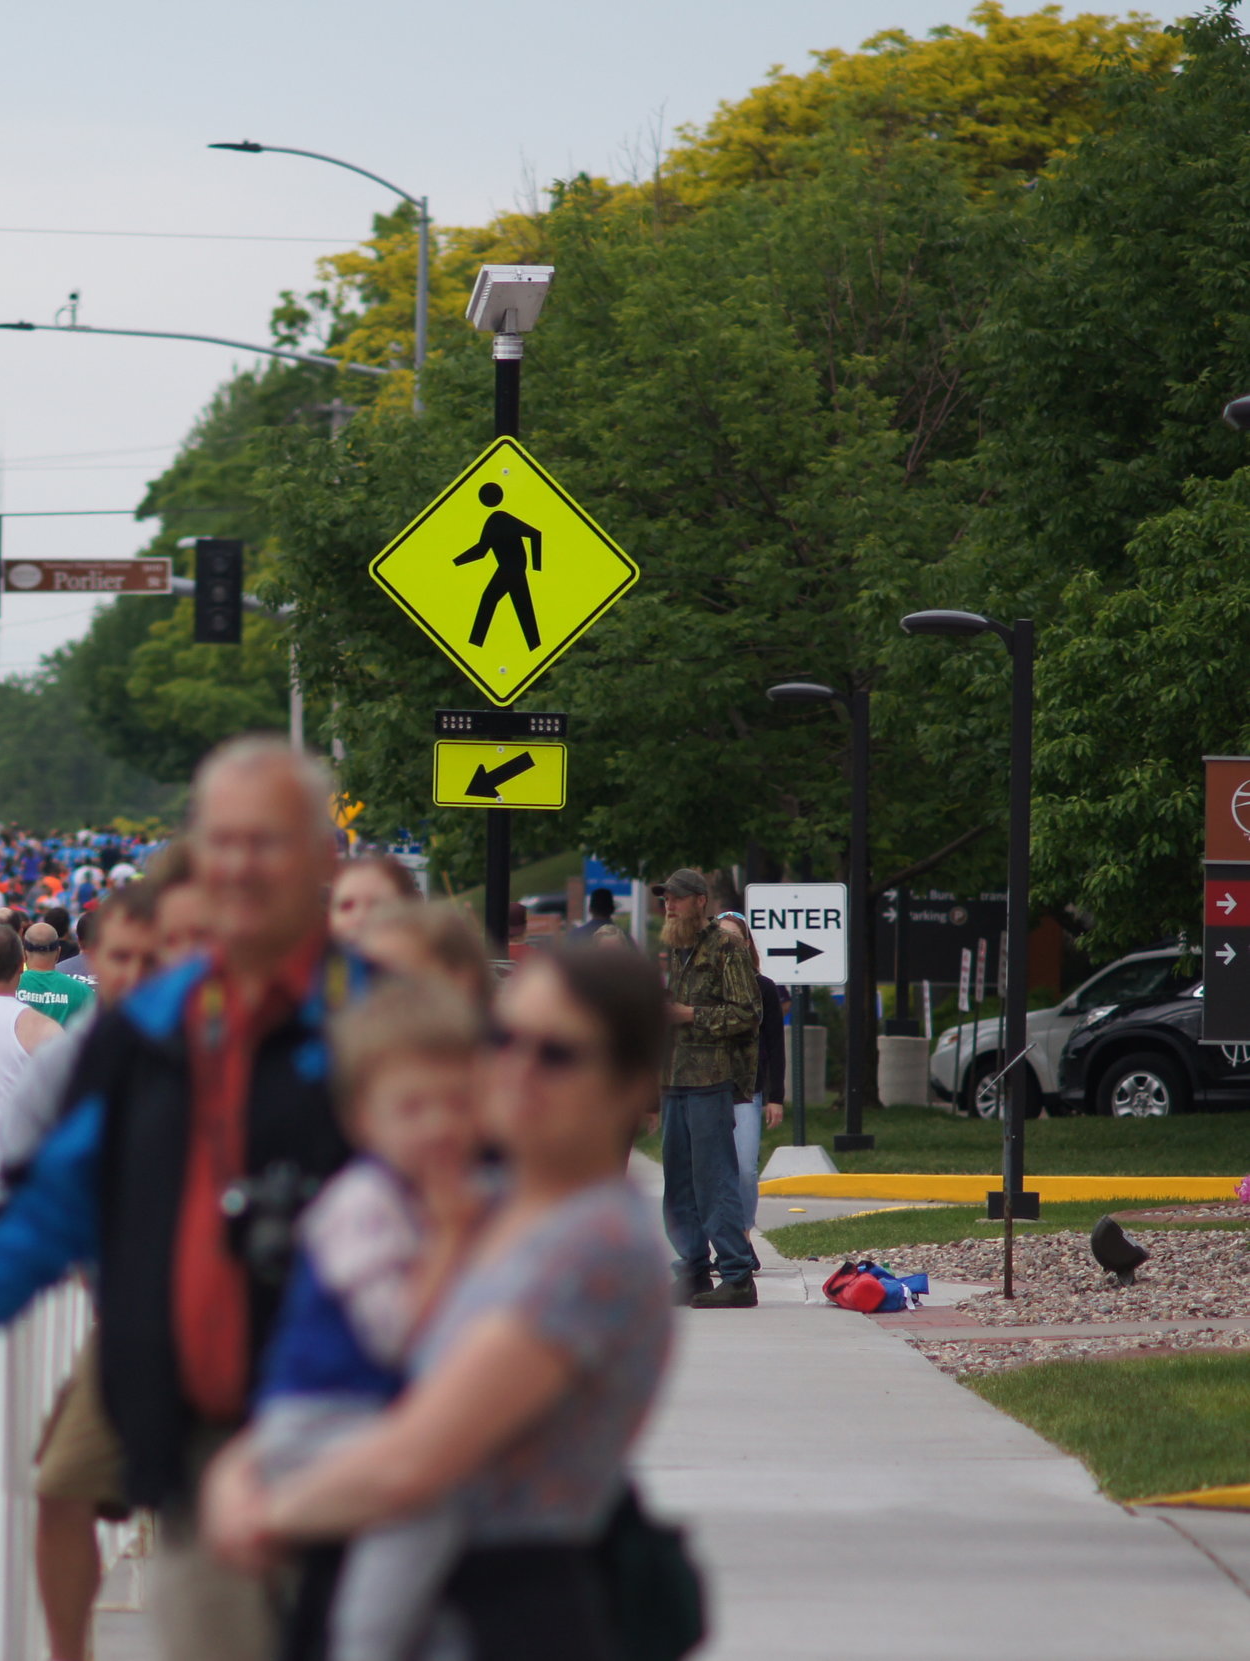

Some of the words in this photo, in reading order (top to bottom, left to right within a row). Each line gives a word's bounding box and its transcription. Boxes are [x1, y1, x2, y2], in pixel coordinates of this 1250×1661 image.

[54, 570, 126, 590] Porlier
[750, 909, 841, 929] ENTER
[909, 911, 947, 923] arking
[15, 990, 68, 1004] GREENTEAM
